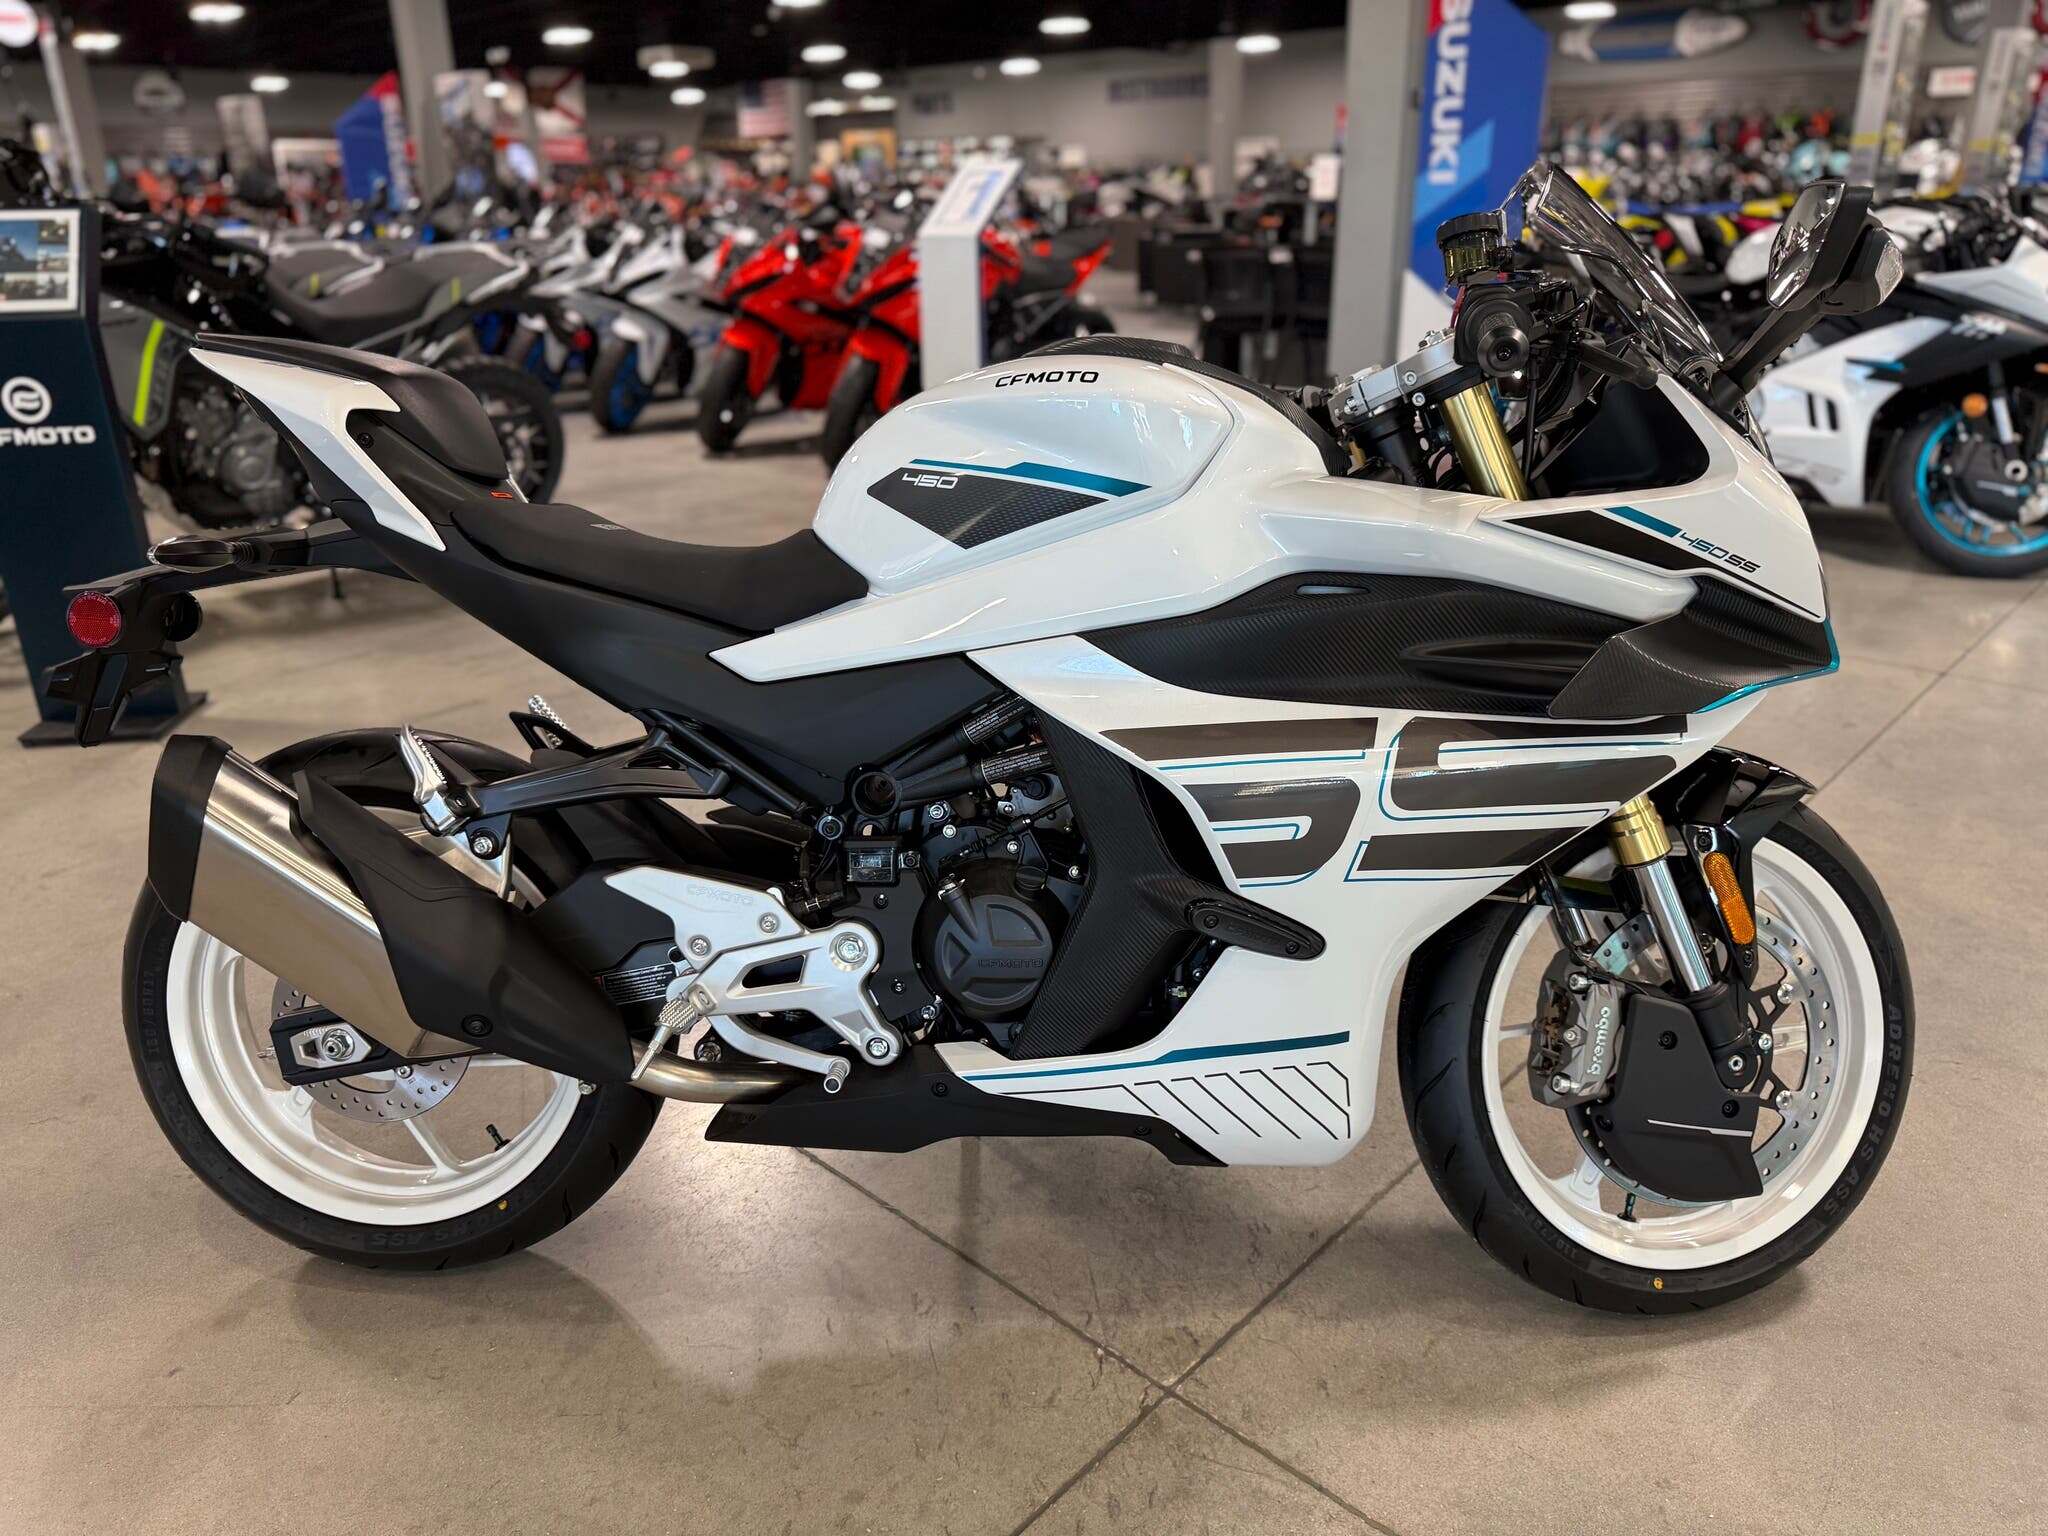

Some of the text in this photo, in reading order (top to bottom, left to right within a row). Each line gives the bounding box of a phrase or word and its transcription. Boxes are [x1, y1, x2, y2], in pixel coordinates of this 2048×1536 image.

[995, 370, 1100, 388] CFMOTO
[901, 472, 959, 490] 450
[1679, 532, 1762, 573] 450SS
[1586, 1006, 1612, 1076] brembo
[1876, 1003, 1905, 1119] ADRENO
